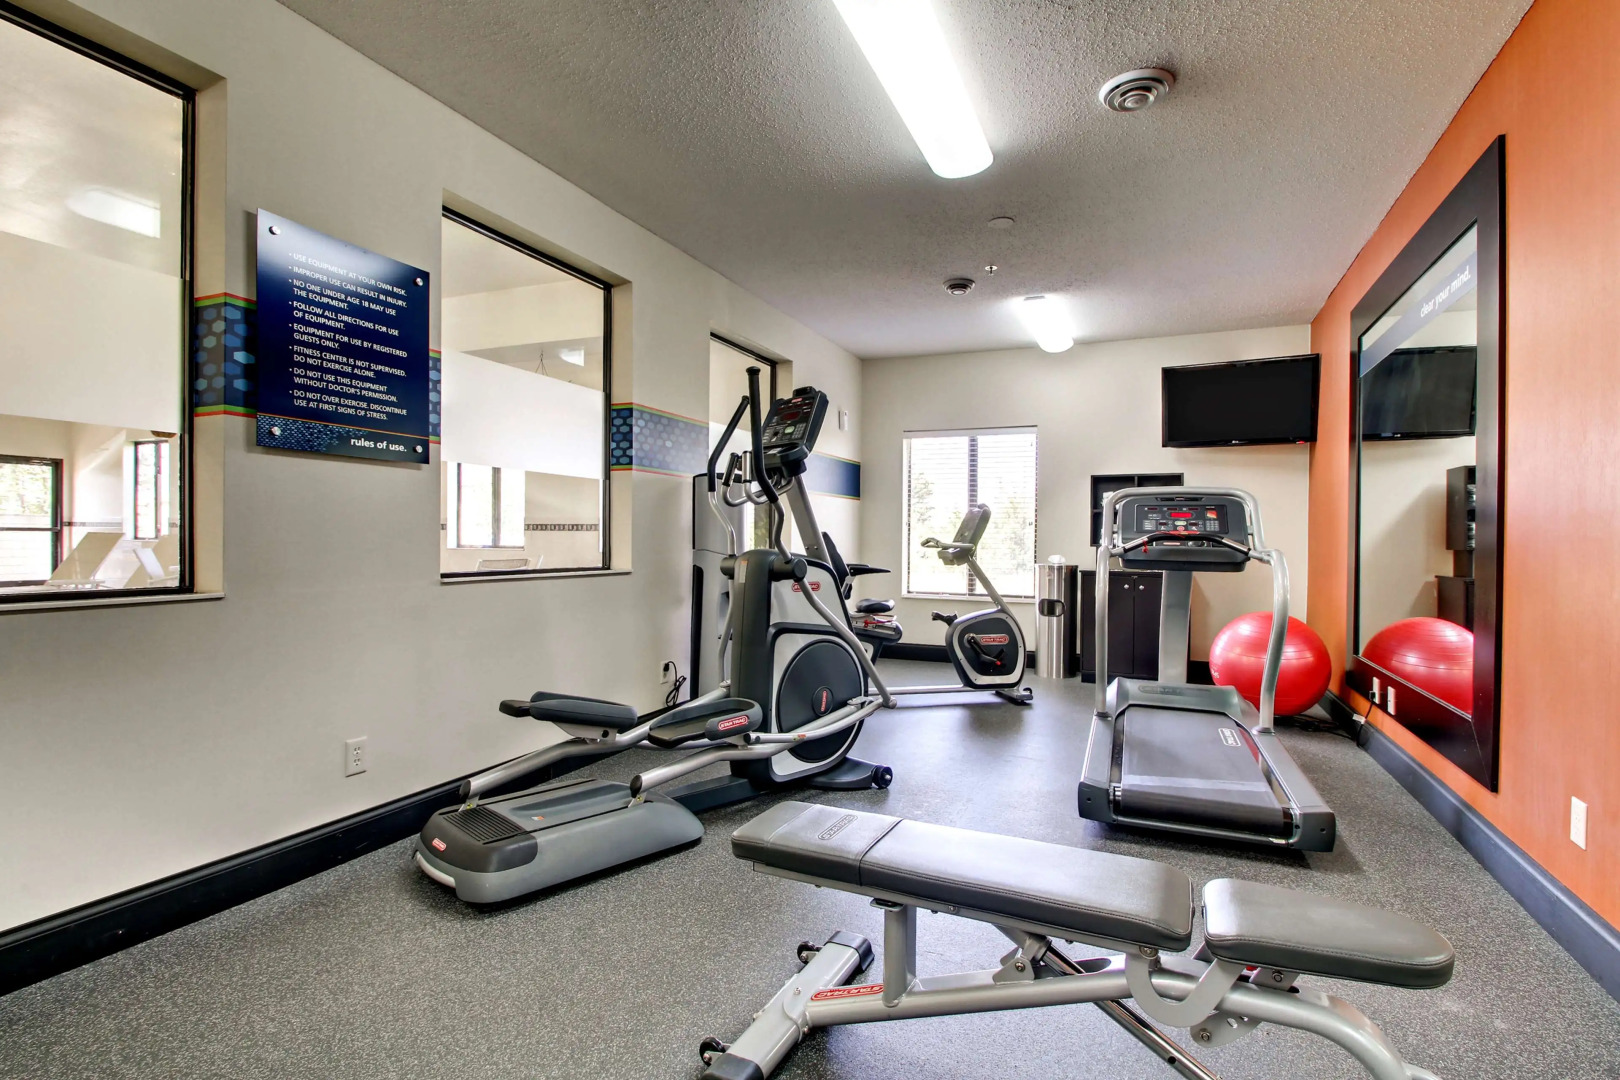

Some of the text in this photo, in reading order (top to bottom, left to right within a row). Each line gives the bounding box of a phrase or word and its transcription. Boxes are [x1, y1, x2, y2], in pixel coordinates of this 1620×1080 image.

[293, 253, 307, 262] USE
[308, 258, 347, 275] EQUIPMENT
[358, 275, 376, 286] YOUR
[376, 281, 393, 291] OWN
[393, 287, 408, 297] RISK.
[293, 266, 408, 308] IMPROPER USE CAN RESULT IN INJURY.
[293, 278, 397, 316] NO ONE UNDER AGE 18 MAY USE
[293, 287, 349, 310] THE EQUIPMENT.
[1421, 265, 1471, 318] clear your mind.
[293, 301, 400, 337] FOLLOW ALL DIRECTIONS FOR USE
[293, 310, 346, 330] OF EQUIPMENT.
[293, 323, 408, 358] EQUIPMENT FOR USE BY REGISTERED
[293, 332, 341, 350] GUESTS ONLY.
[293, 345, 407, 378] FITNESS CENTER IS NOT SUPERVISED.
[293, 354, 377, 379] DO NOT EXERCISE ALONE.
[293, 367, 388, 392] DO NOT USE THIS EQUIPMENT
[293, 376, 399, 403] WITHOUT DOCTOR'S PERMISSION.
[293, 389, 408, 416] DO NOT OVER EXERCISE. DISCONTINUE
[293, 398, 307, 407] USE
[308, 401, 318, 409] AT
[318, 402, 337, 411] FIRST
[337, 405, 356, 415] SIGNS
[366, 410, 389, 421] STRESS.
[350, 437, 407, 452] rules of use.
[816, 985, 882, 998] STAR TRAC
